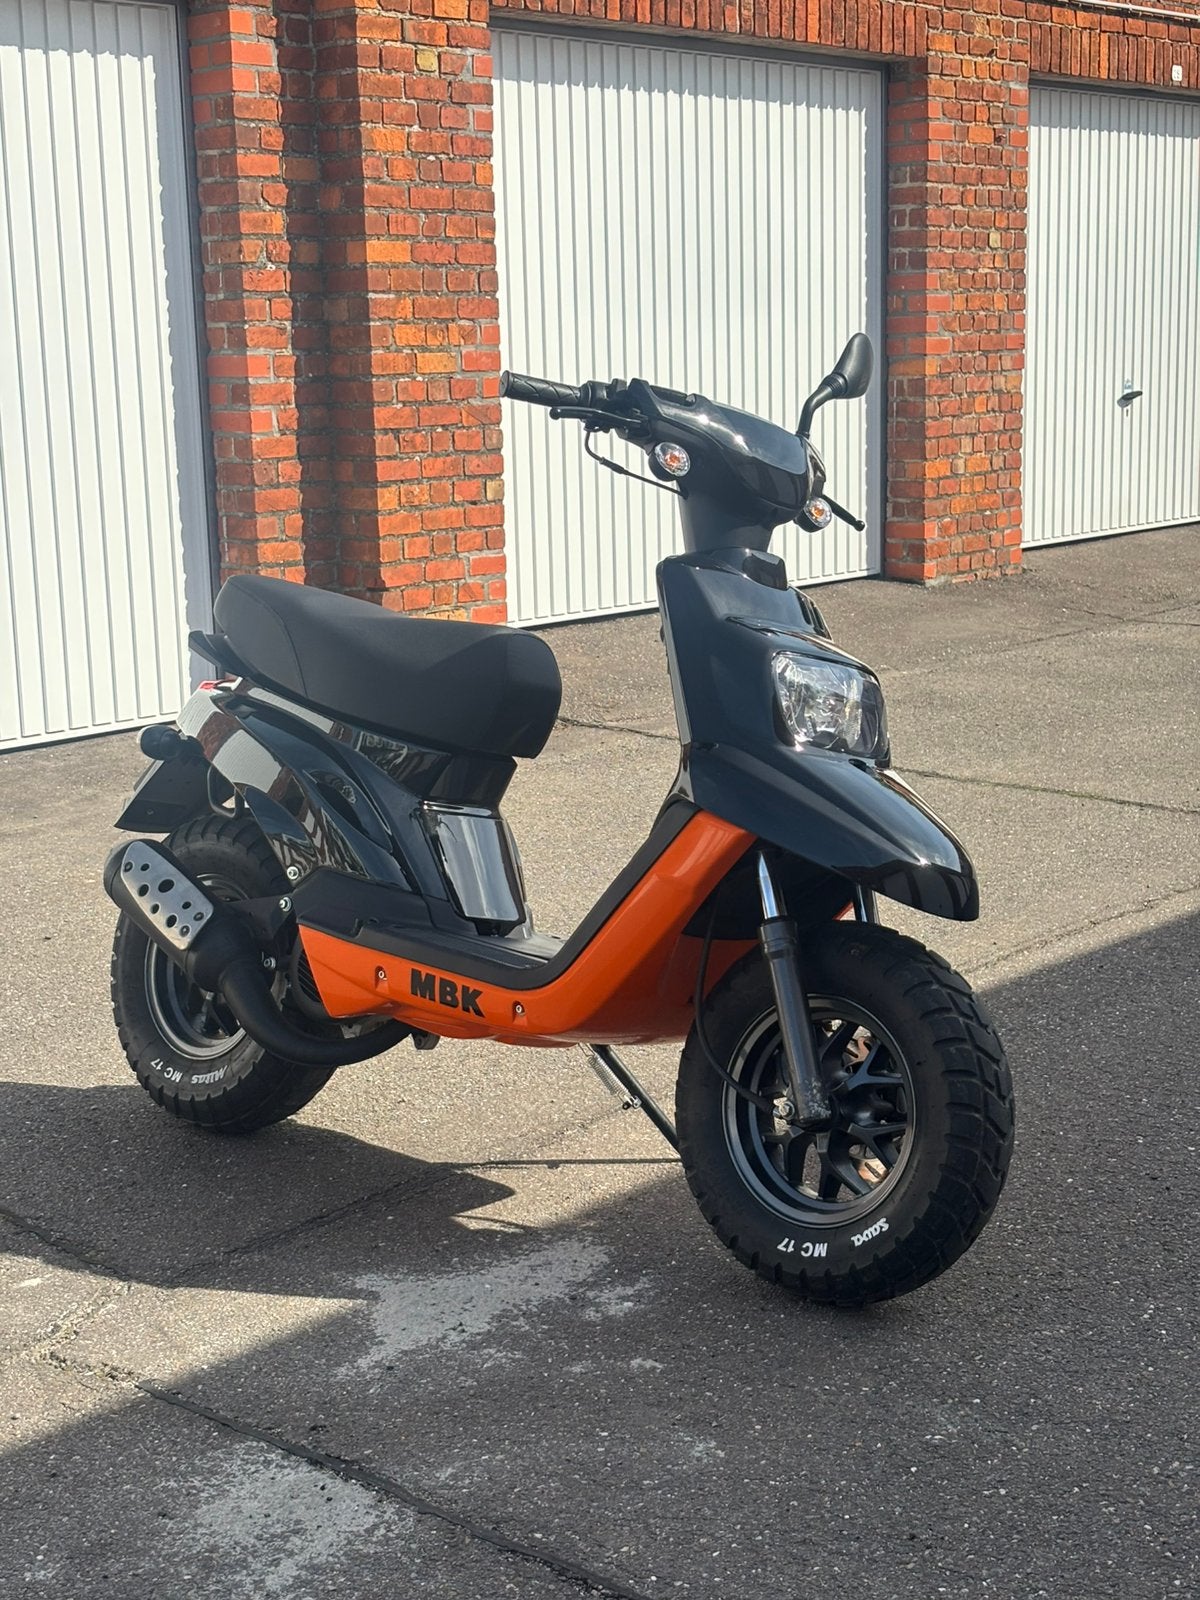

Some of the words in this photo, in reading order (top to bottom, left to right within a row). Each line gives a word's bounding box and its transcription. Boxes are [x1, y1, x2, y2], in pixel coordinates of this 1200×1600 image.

[410, 968, 485, 1018] MBK
[150, 1058, 164, 1071] 17
[163, 1067, 183, 1083] MC
[776, 1237, 795, 1253] 17
[800, 1242, 828, 1257] MC
